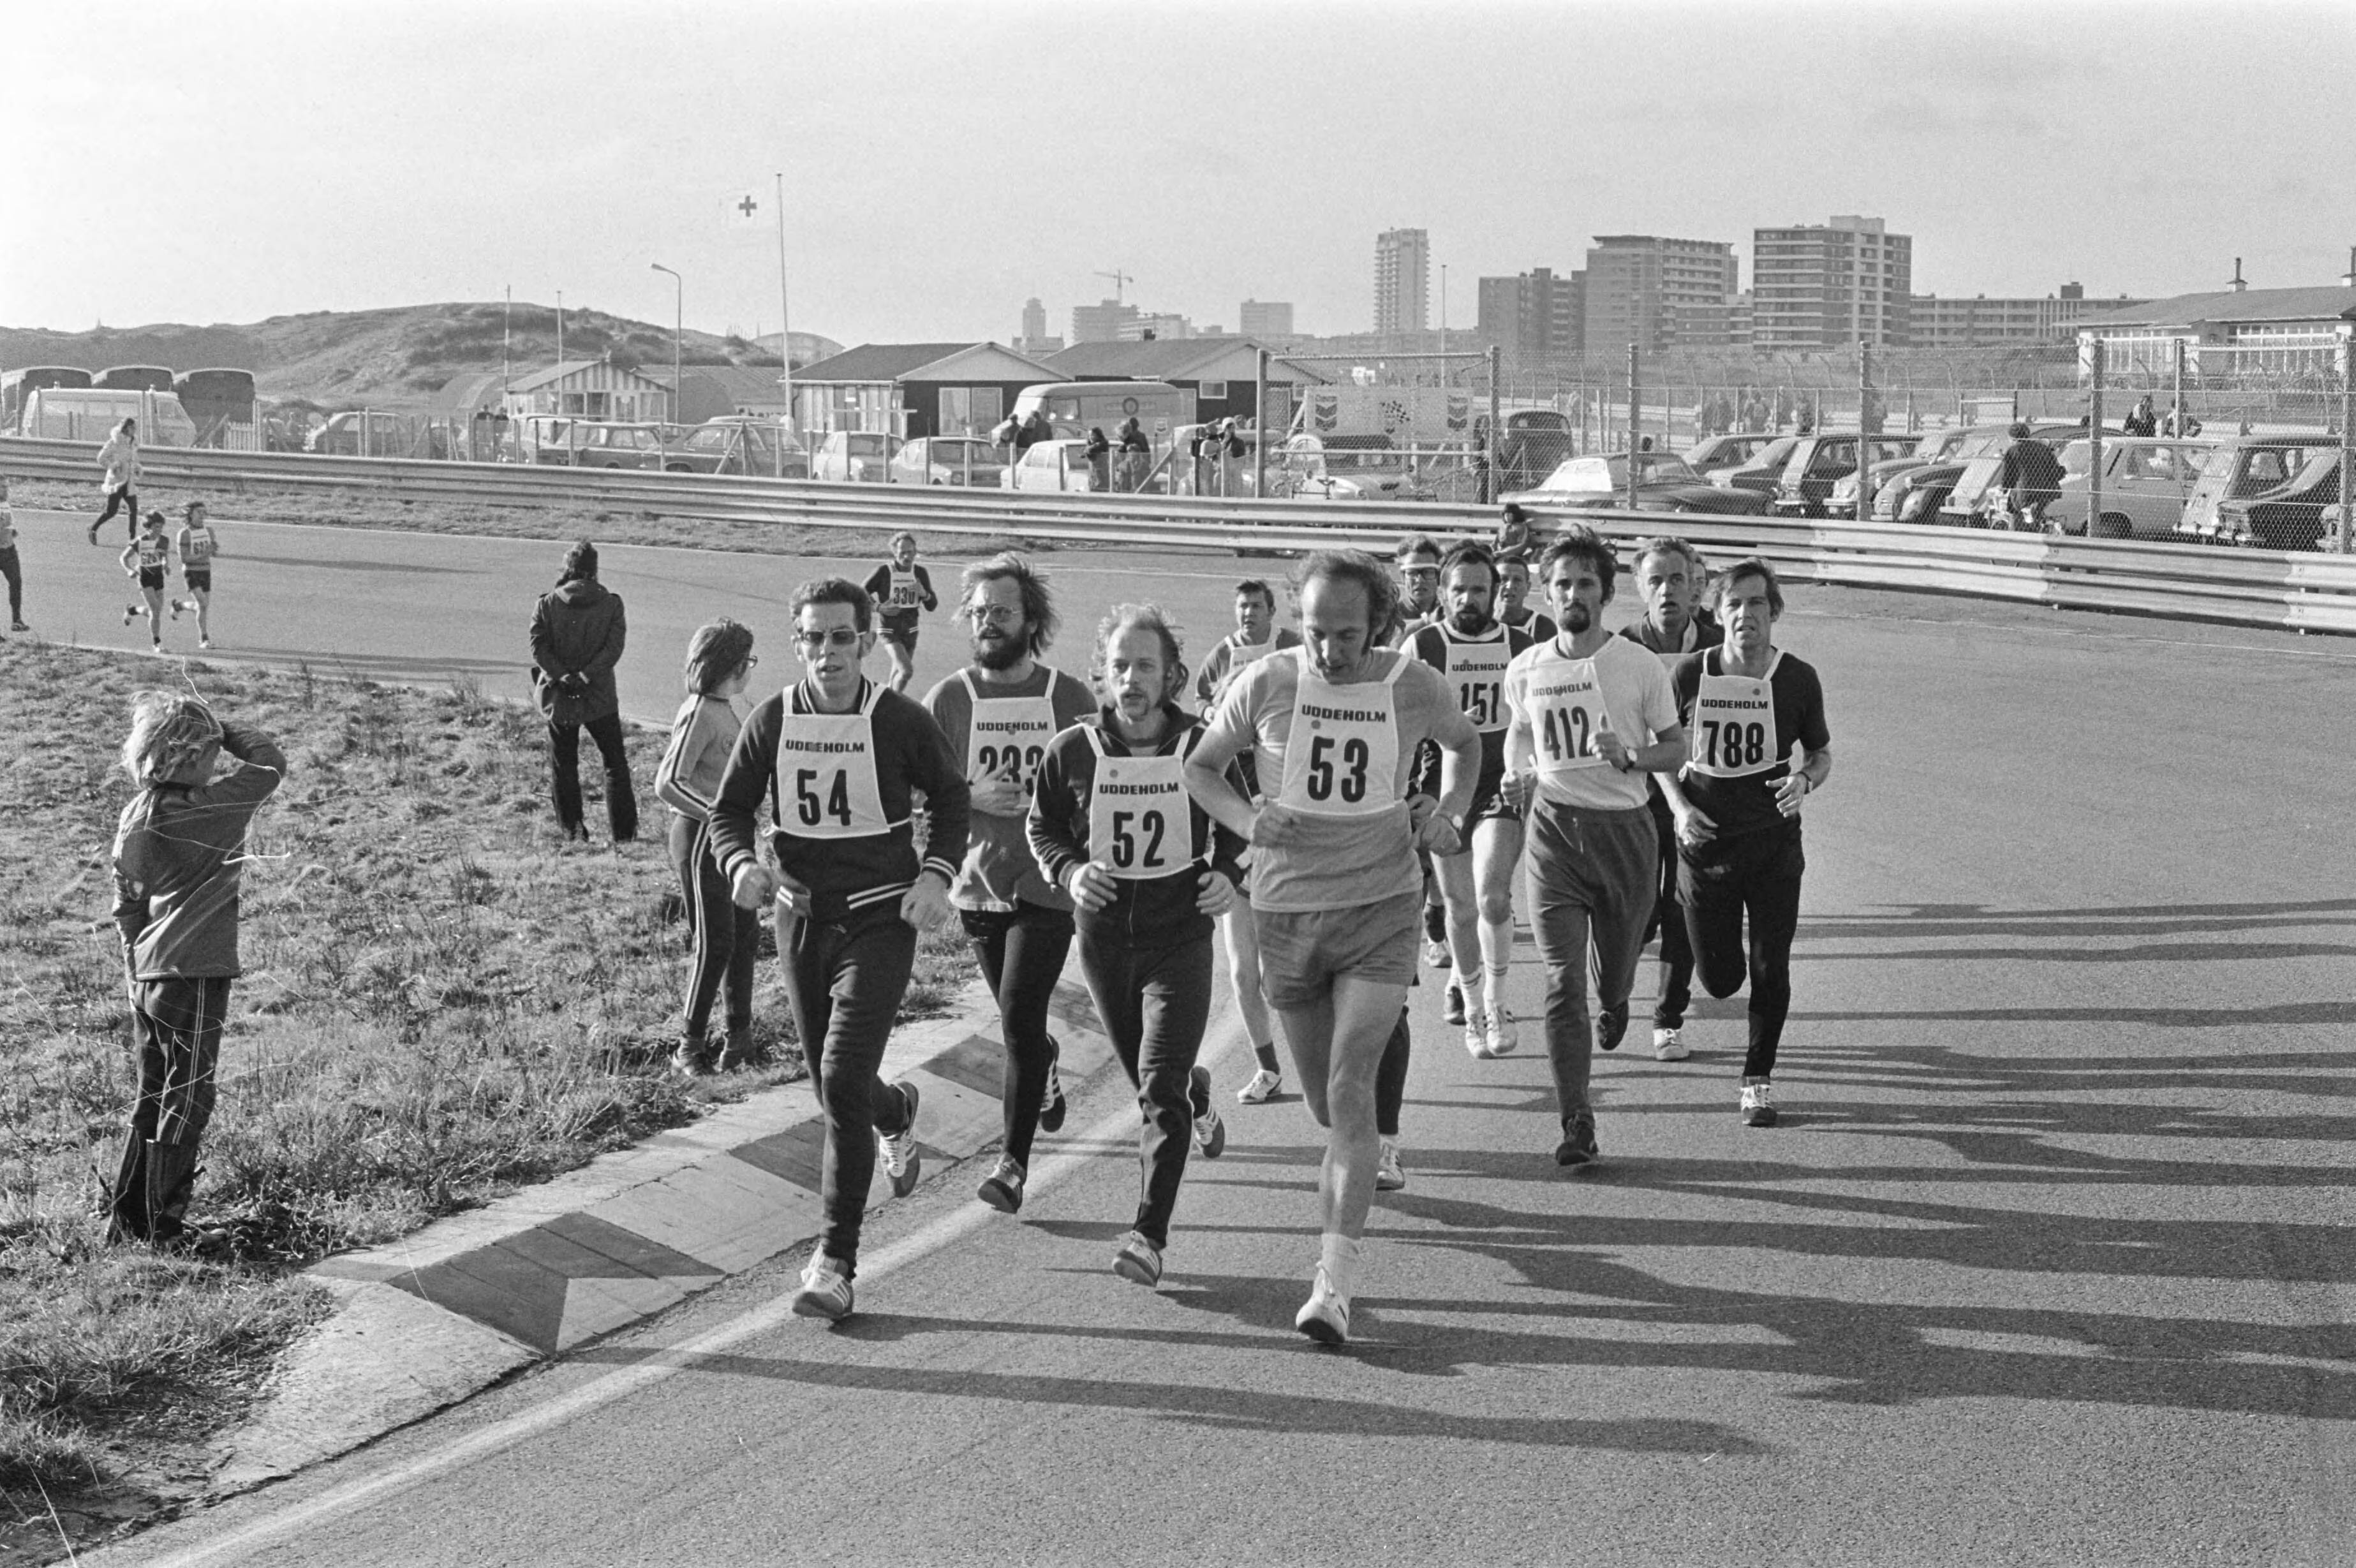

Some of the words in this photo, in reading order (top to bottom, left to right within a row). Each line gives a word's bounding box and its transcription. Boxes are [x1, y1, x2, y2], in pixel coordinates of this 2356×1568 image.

[894, 587, 915, 605] 330
[1451, 663, 1508, 671] UDDEHOLM
[1460, 682, 1499, 725] 151
[1701, 699, 1768, 709] UDDEHOLM
[1301, 704, 1386, 722] UDDEHOLM
[977, 721, 1048, 732] UDDEHOLM
[1544, 706, 1594, 760] 412
[785, 739, 864, 753] UDDEHOLM
[1703, 720, 1765, 768] 788
[1307, 736, 1369, 802] 53
[797, 769, 852, 826] 54
[1099, 782, 1179, 795] UDDEHOLM
[1112, 810, 1165, 868] 52
